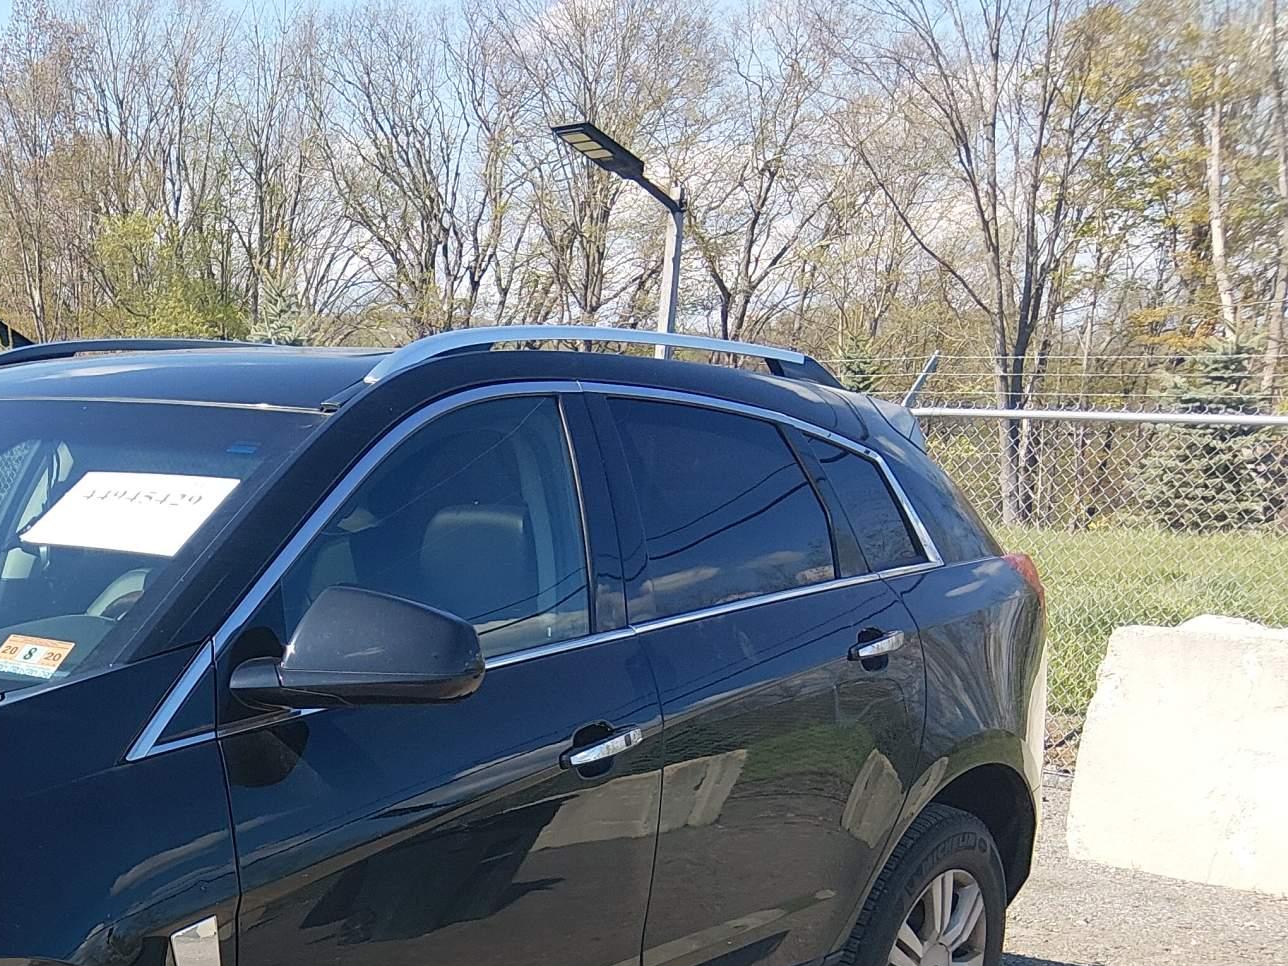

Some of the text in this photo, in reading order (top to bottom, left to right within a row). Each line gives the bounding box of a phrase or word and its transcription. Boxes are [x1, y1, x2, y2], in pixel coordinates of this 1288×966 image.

[1, 645, 63, 662] 20 8 20
